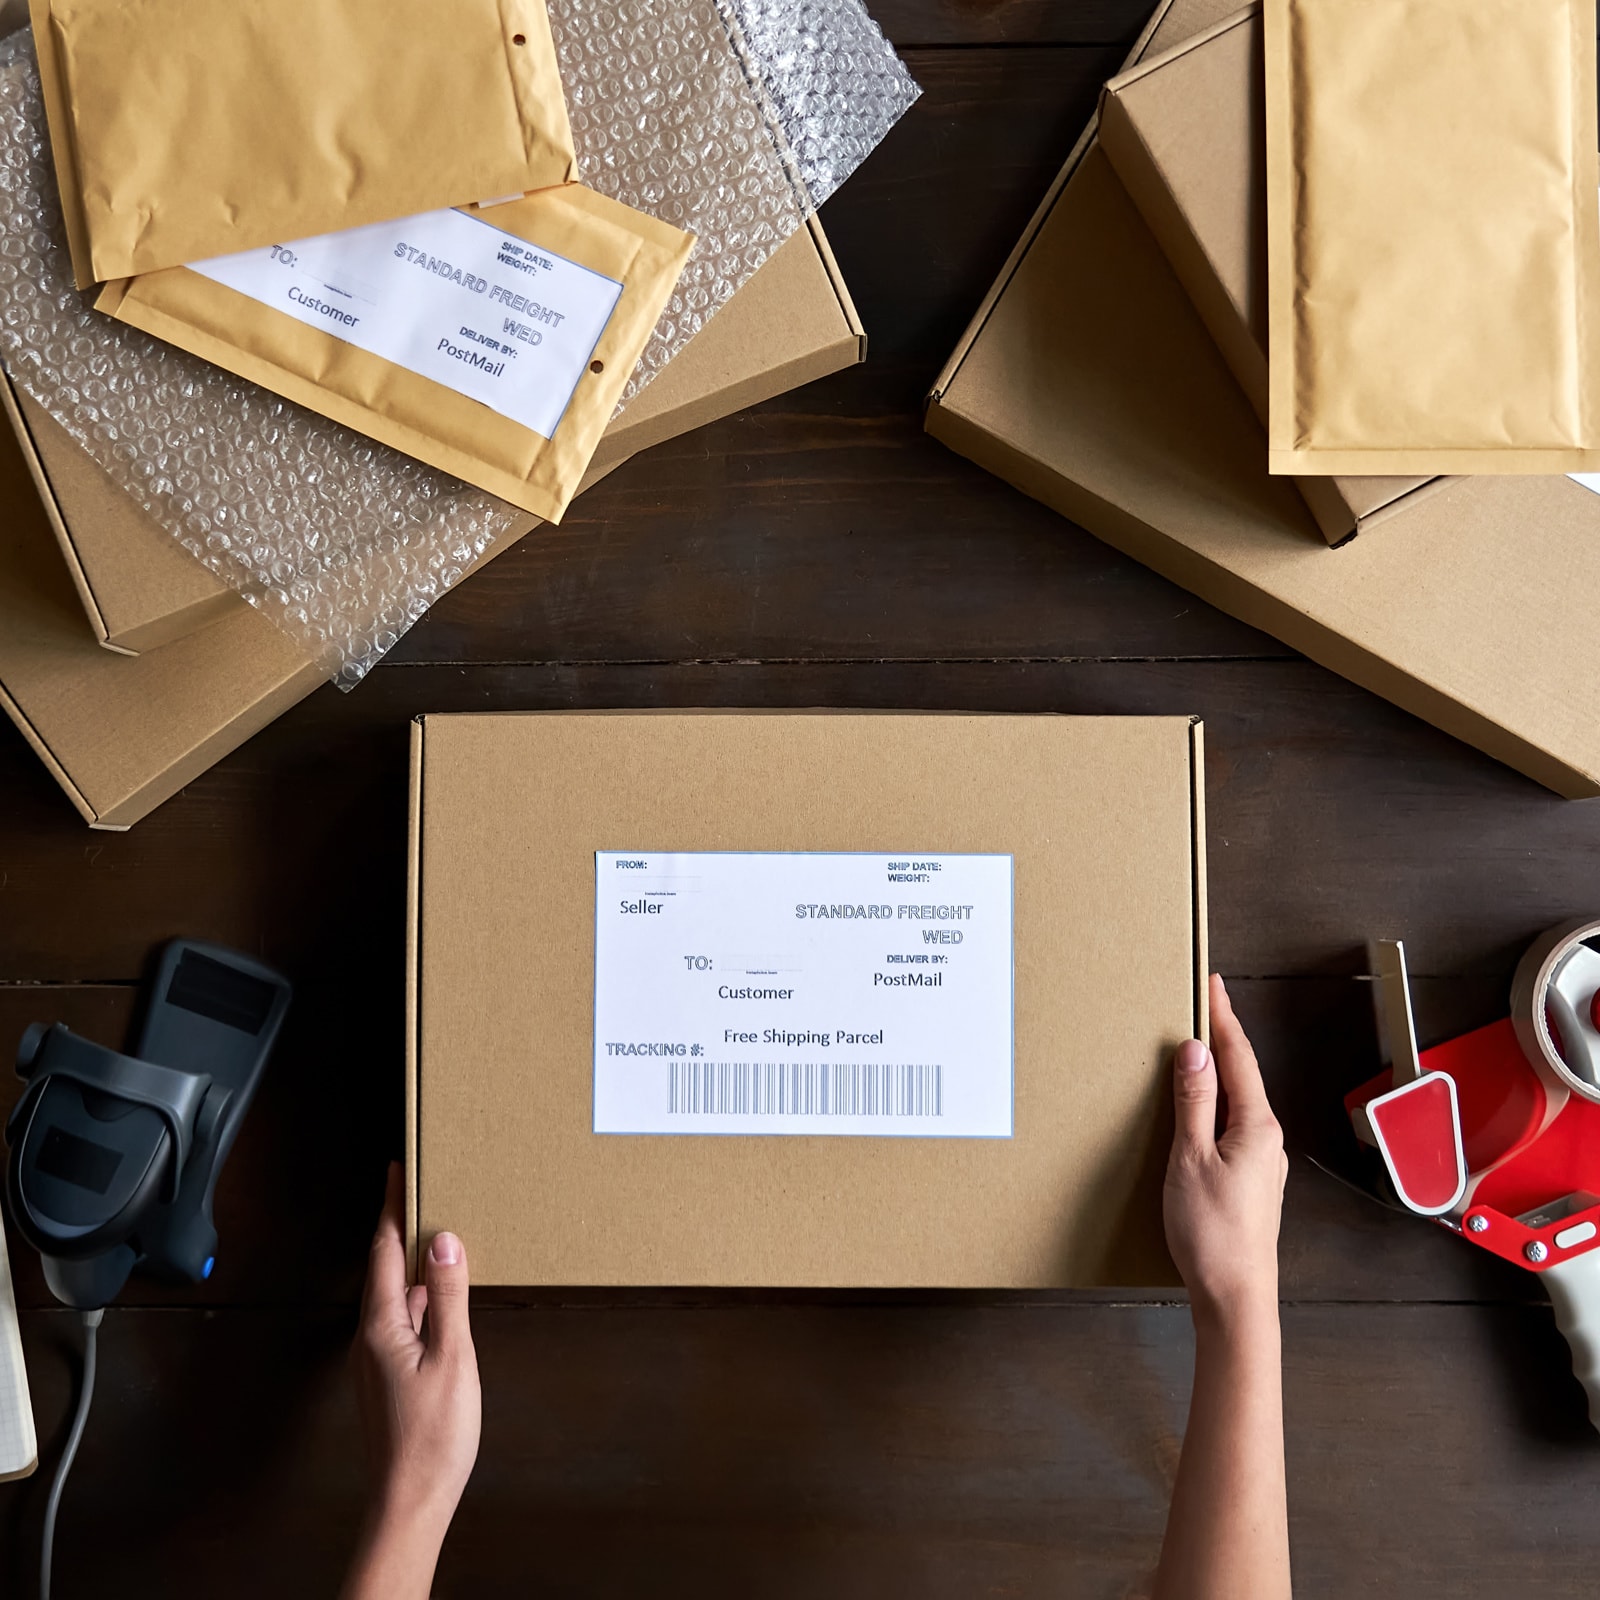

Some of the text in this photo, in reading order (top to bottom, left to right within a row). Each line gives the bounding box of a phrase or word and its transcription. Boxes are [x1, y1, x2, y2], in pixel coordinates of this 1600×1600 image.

[271, 245, 298, 268] TO:
[497, 252, 536, 276] WEIGHT:
[502, 241, 553, 271] SHIP DATE:
[394, 243, 565, 328] STANDARD FREIGHT
[288, 286, 360, 327] Customer
[502, 317, 543, 346] WED
[459, 326, 518, 359] DELIVER BY:
[437, 338, 505, 377] PostMail
[615, 860, 648, 870] FROM:
[887, 862, 942, 872] SHIP DATE:
[887, 873, 930, 883] WEIGHT:
[619, 899, 664, 915] Seller
[795, 904, 974, 920] STANDARD FREIGHT
[922, 929, 964, 945] WED
[684, 955, 713, 971] TO:
[886, 954, 949, 965] DELIVER BY:
[873, 972, 942, 987] PostMail
[718, 986, 795, 1000] Customer
[724, 1028, 884, 1047] Free Shipping Parcel
[606, 1042, 705, 1057] TRACKING #:
